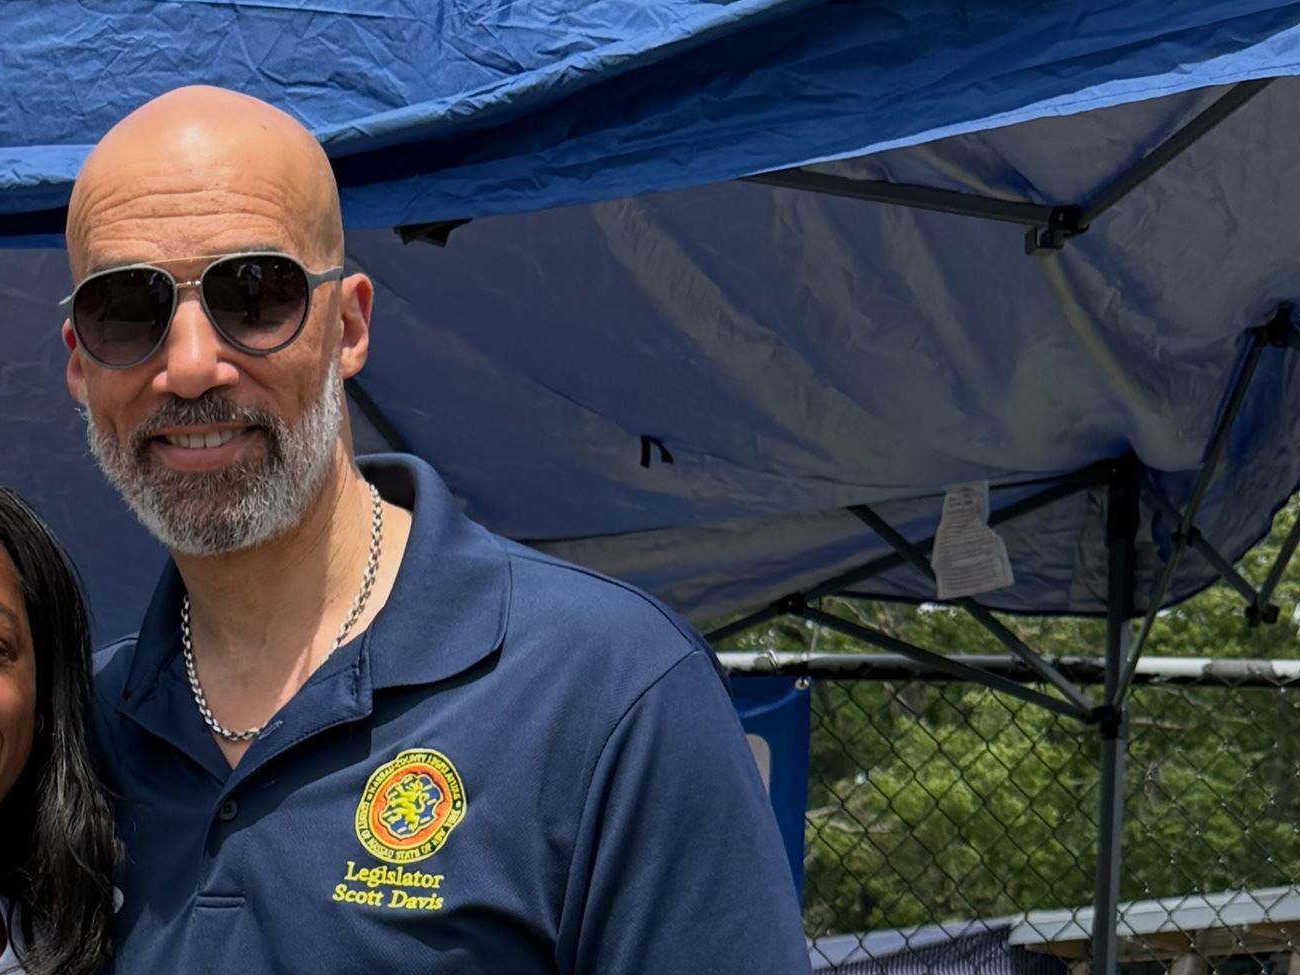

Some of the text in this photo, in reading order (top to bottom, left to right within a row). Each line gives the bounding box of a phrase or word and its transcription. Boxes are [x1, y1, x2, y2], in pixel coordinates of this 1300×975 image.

[344, 861, 444, 889] Legislator
[332, 884, 444, 911] Scott Davis
